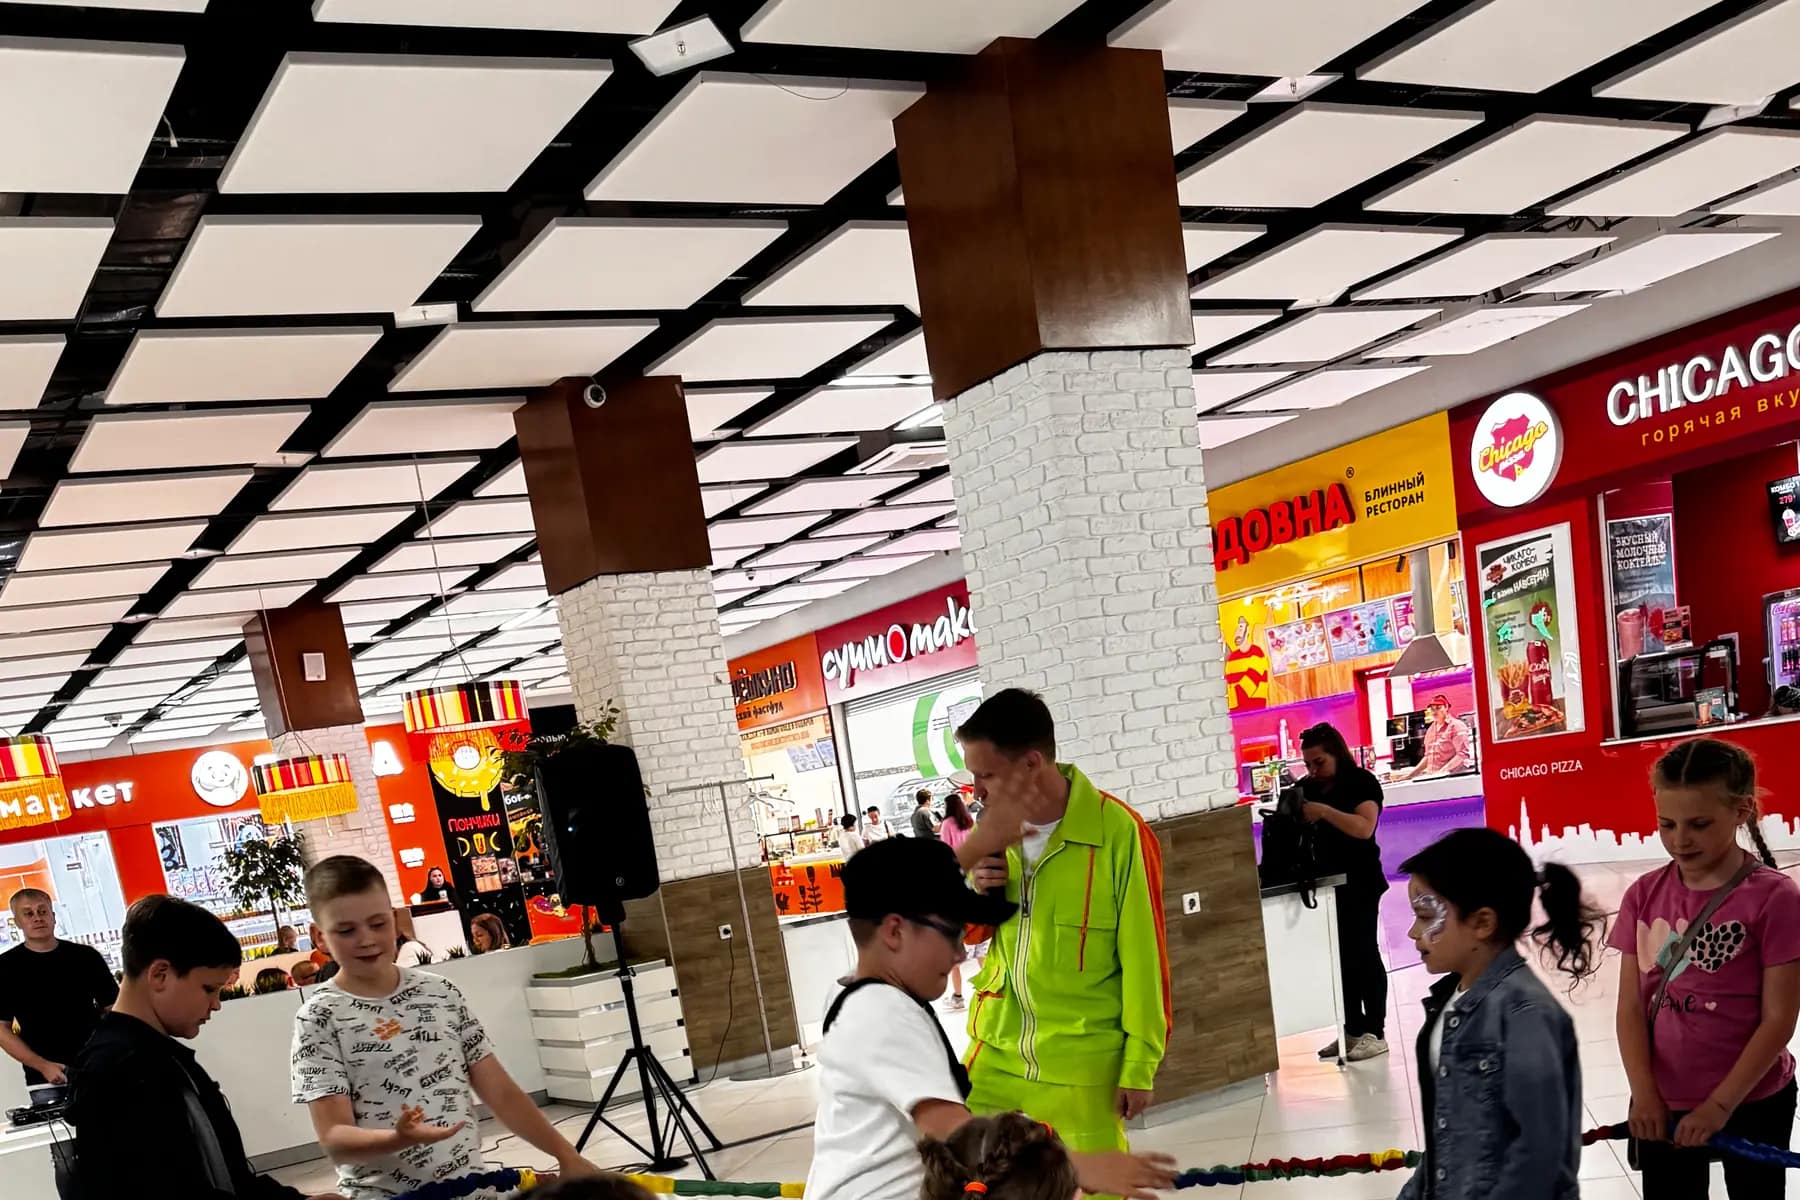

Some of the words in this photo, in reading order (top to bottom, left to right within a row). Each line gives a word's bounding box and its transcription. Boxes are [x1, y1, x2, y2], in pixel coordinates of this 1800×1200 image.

[1641, 406, 1742, 447] горячая
[1478, 421, 1548, 472] Chicago
[1365, 471, 1425, 503] БЛИННЫЙ
[1366, 491, 1424, 518] РЕСТОРАН
[1214, 483, 1355, 572] ДОВНА
[1500, 764, 1548, 780] CHICAGO
[1551, 759, 1583, 774] PIZZA
[448, 813, 500, 832] ПОНЧИКИ
